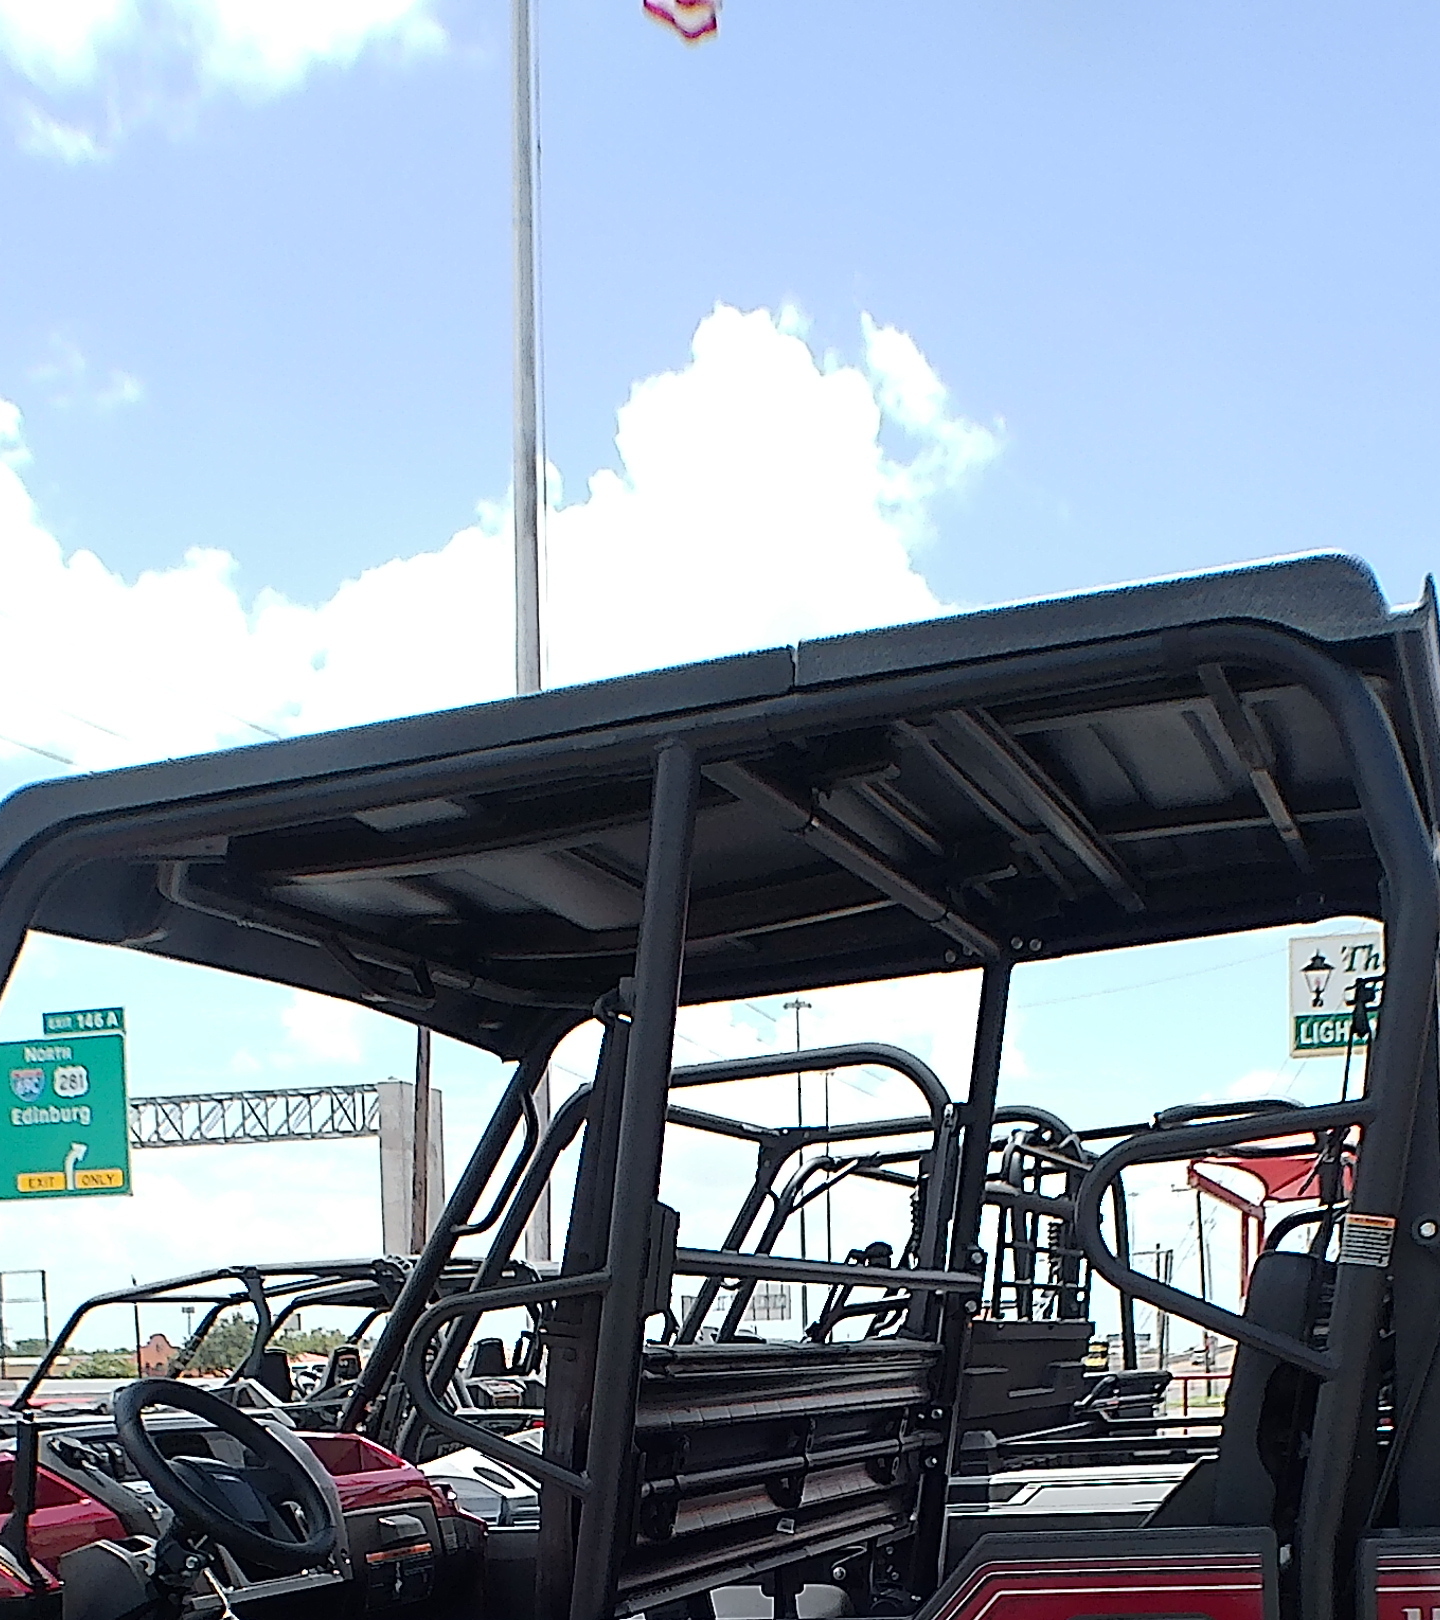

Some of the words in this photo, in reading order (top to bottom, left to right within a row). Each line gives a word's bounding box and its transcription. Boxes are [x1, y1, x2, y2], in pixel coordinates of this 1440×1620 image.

[1341, 944, 1382, 973] Th
[106, 1010, 120, 1028] A
[59, 1073, 85, 1091] 281
[10, 1105, 92, 1126] Edinburg
[27, 1176, 56, 1190] EXIT
[81, 1174, 115, 1187] ONLY
